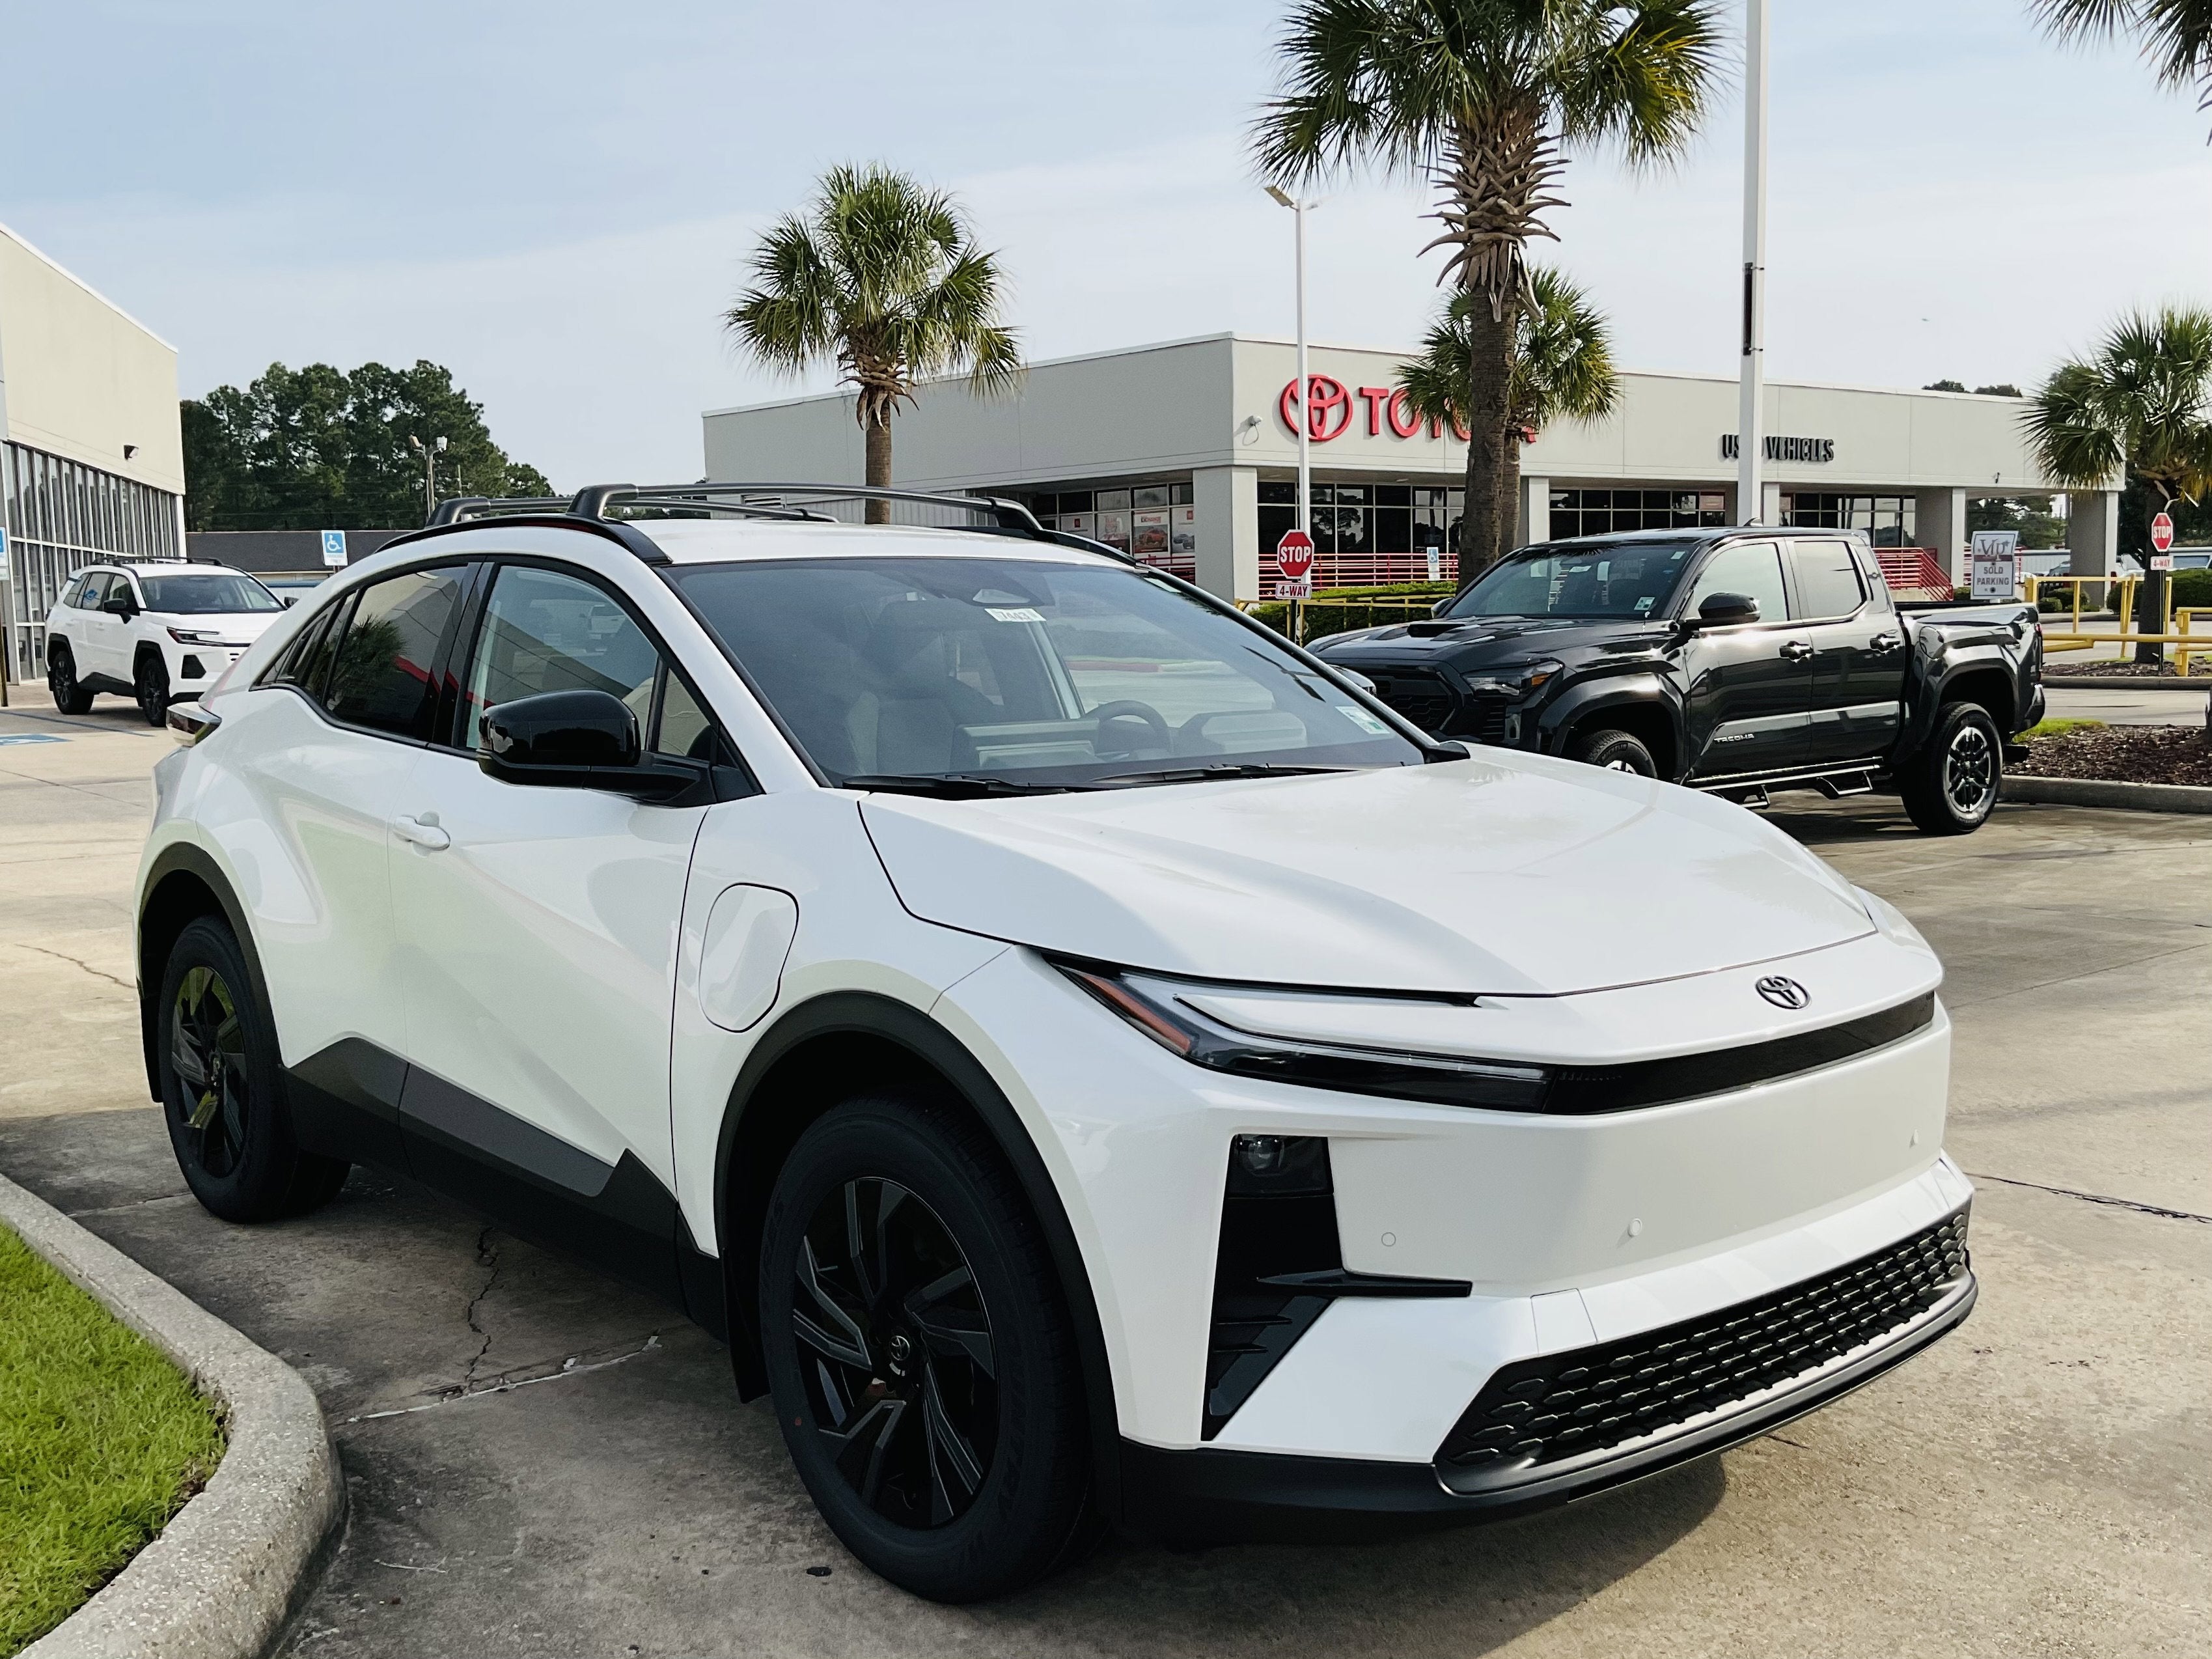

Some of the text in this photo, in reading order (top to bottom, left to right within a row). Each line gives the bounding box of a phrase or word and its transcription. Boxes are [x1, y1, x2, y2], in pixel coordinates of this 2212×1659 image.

[1765, 436, 1834, 462] VEHICLES
[2153, 525, 2171, 539] STOP
[1280, 546, 1311, 563] STOP
[1279, 585, 1308, 596] 4-WAY
[1713, 733, 1755, 742] TACOMA
